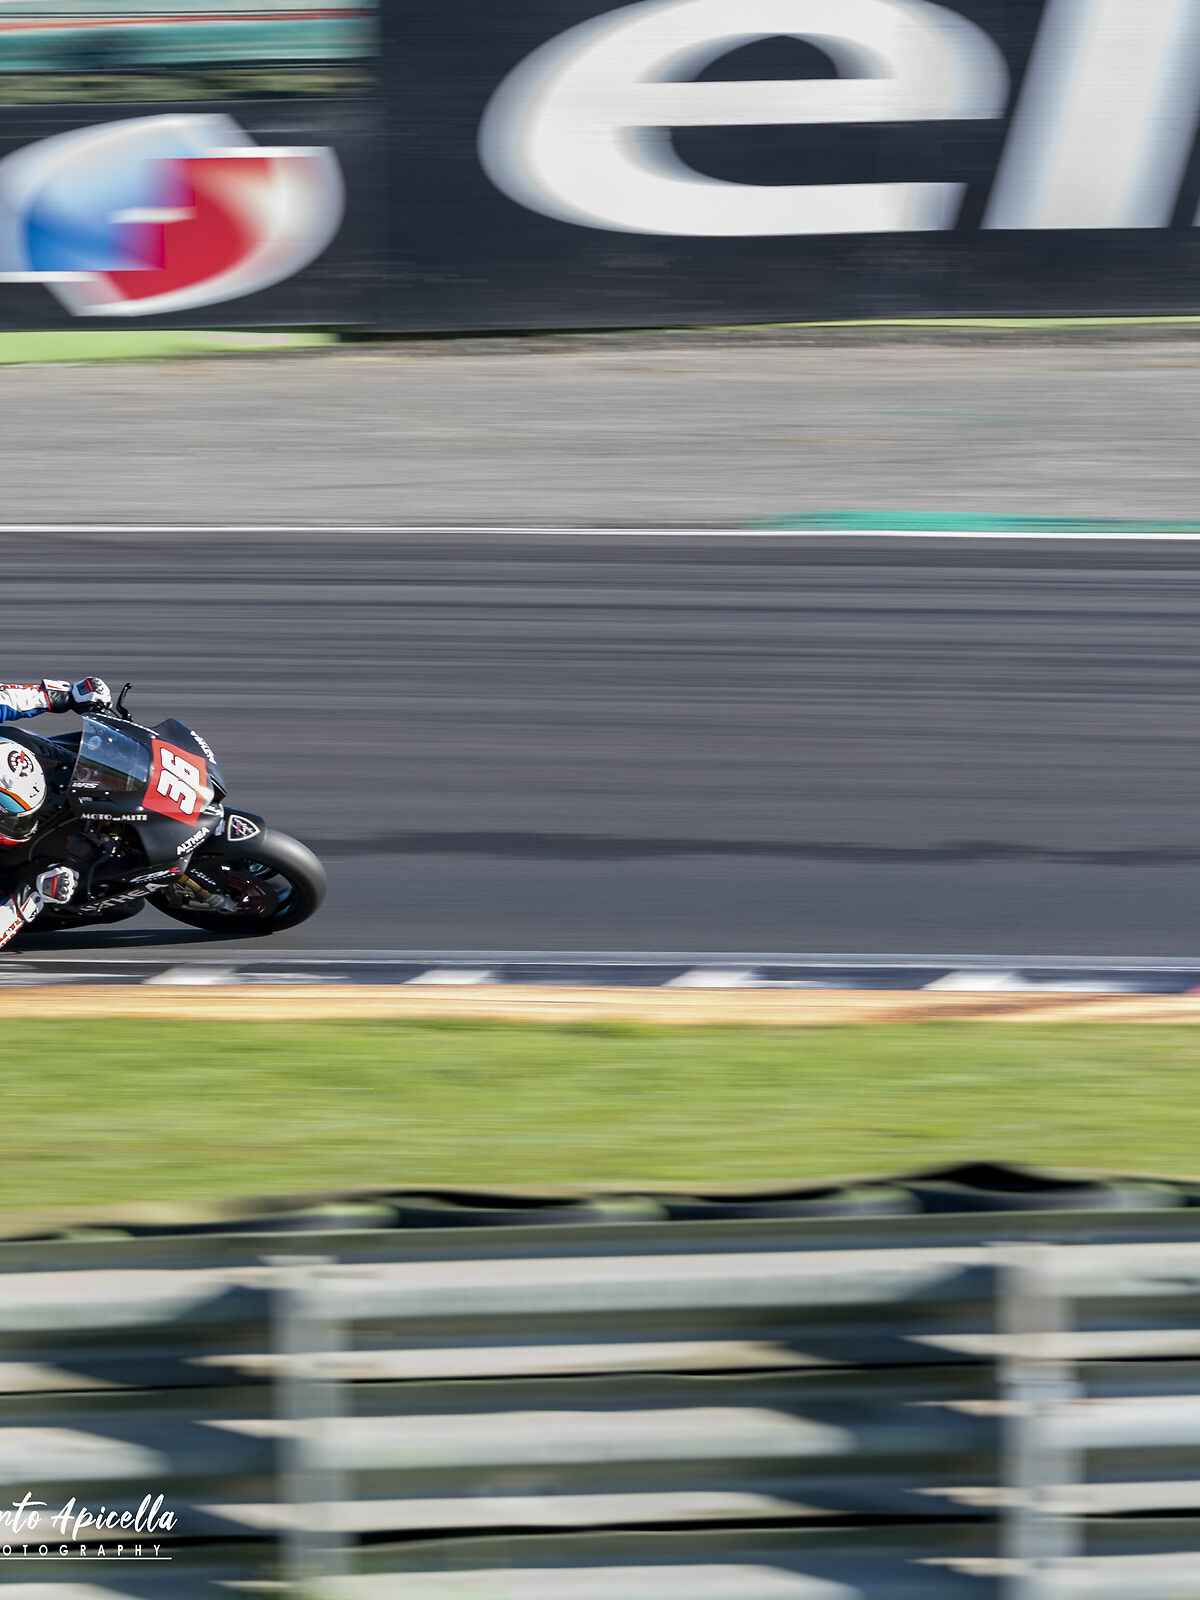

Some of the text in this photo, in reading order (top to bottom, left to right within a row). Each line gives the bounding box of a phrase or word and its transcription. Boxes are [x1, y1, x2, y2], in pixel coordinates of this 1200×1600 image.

[477, 0, 1200, 238] el
[156, 747, 201, 816] 36
[80, 813, 112, 821] MOTO
[176, 826, 210, 855] ALTHEA
